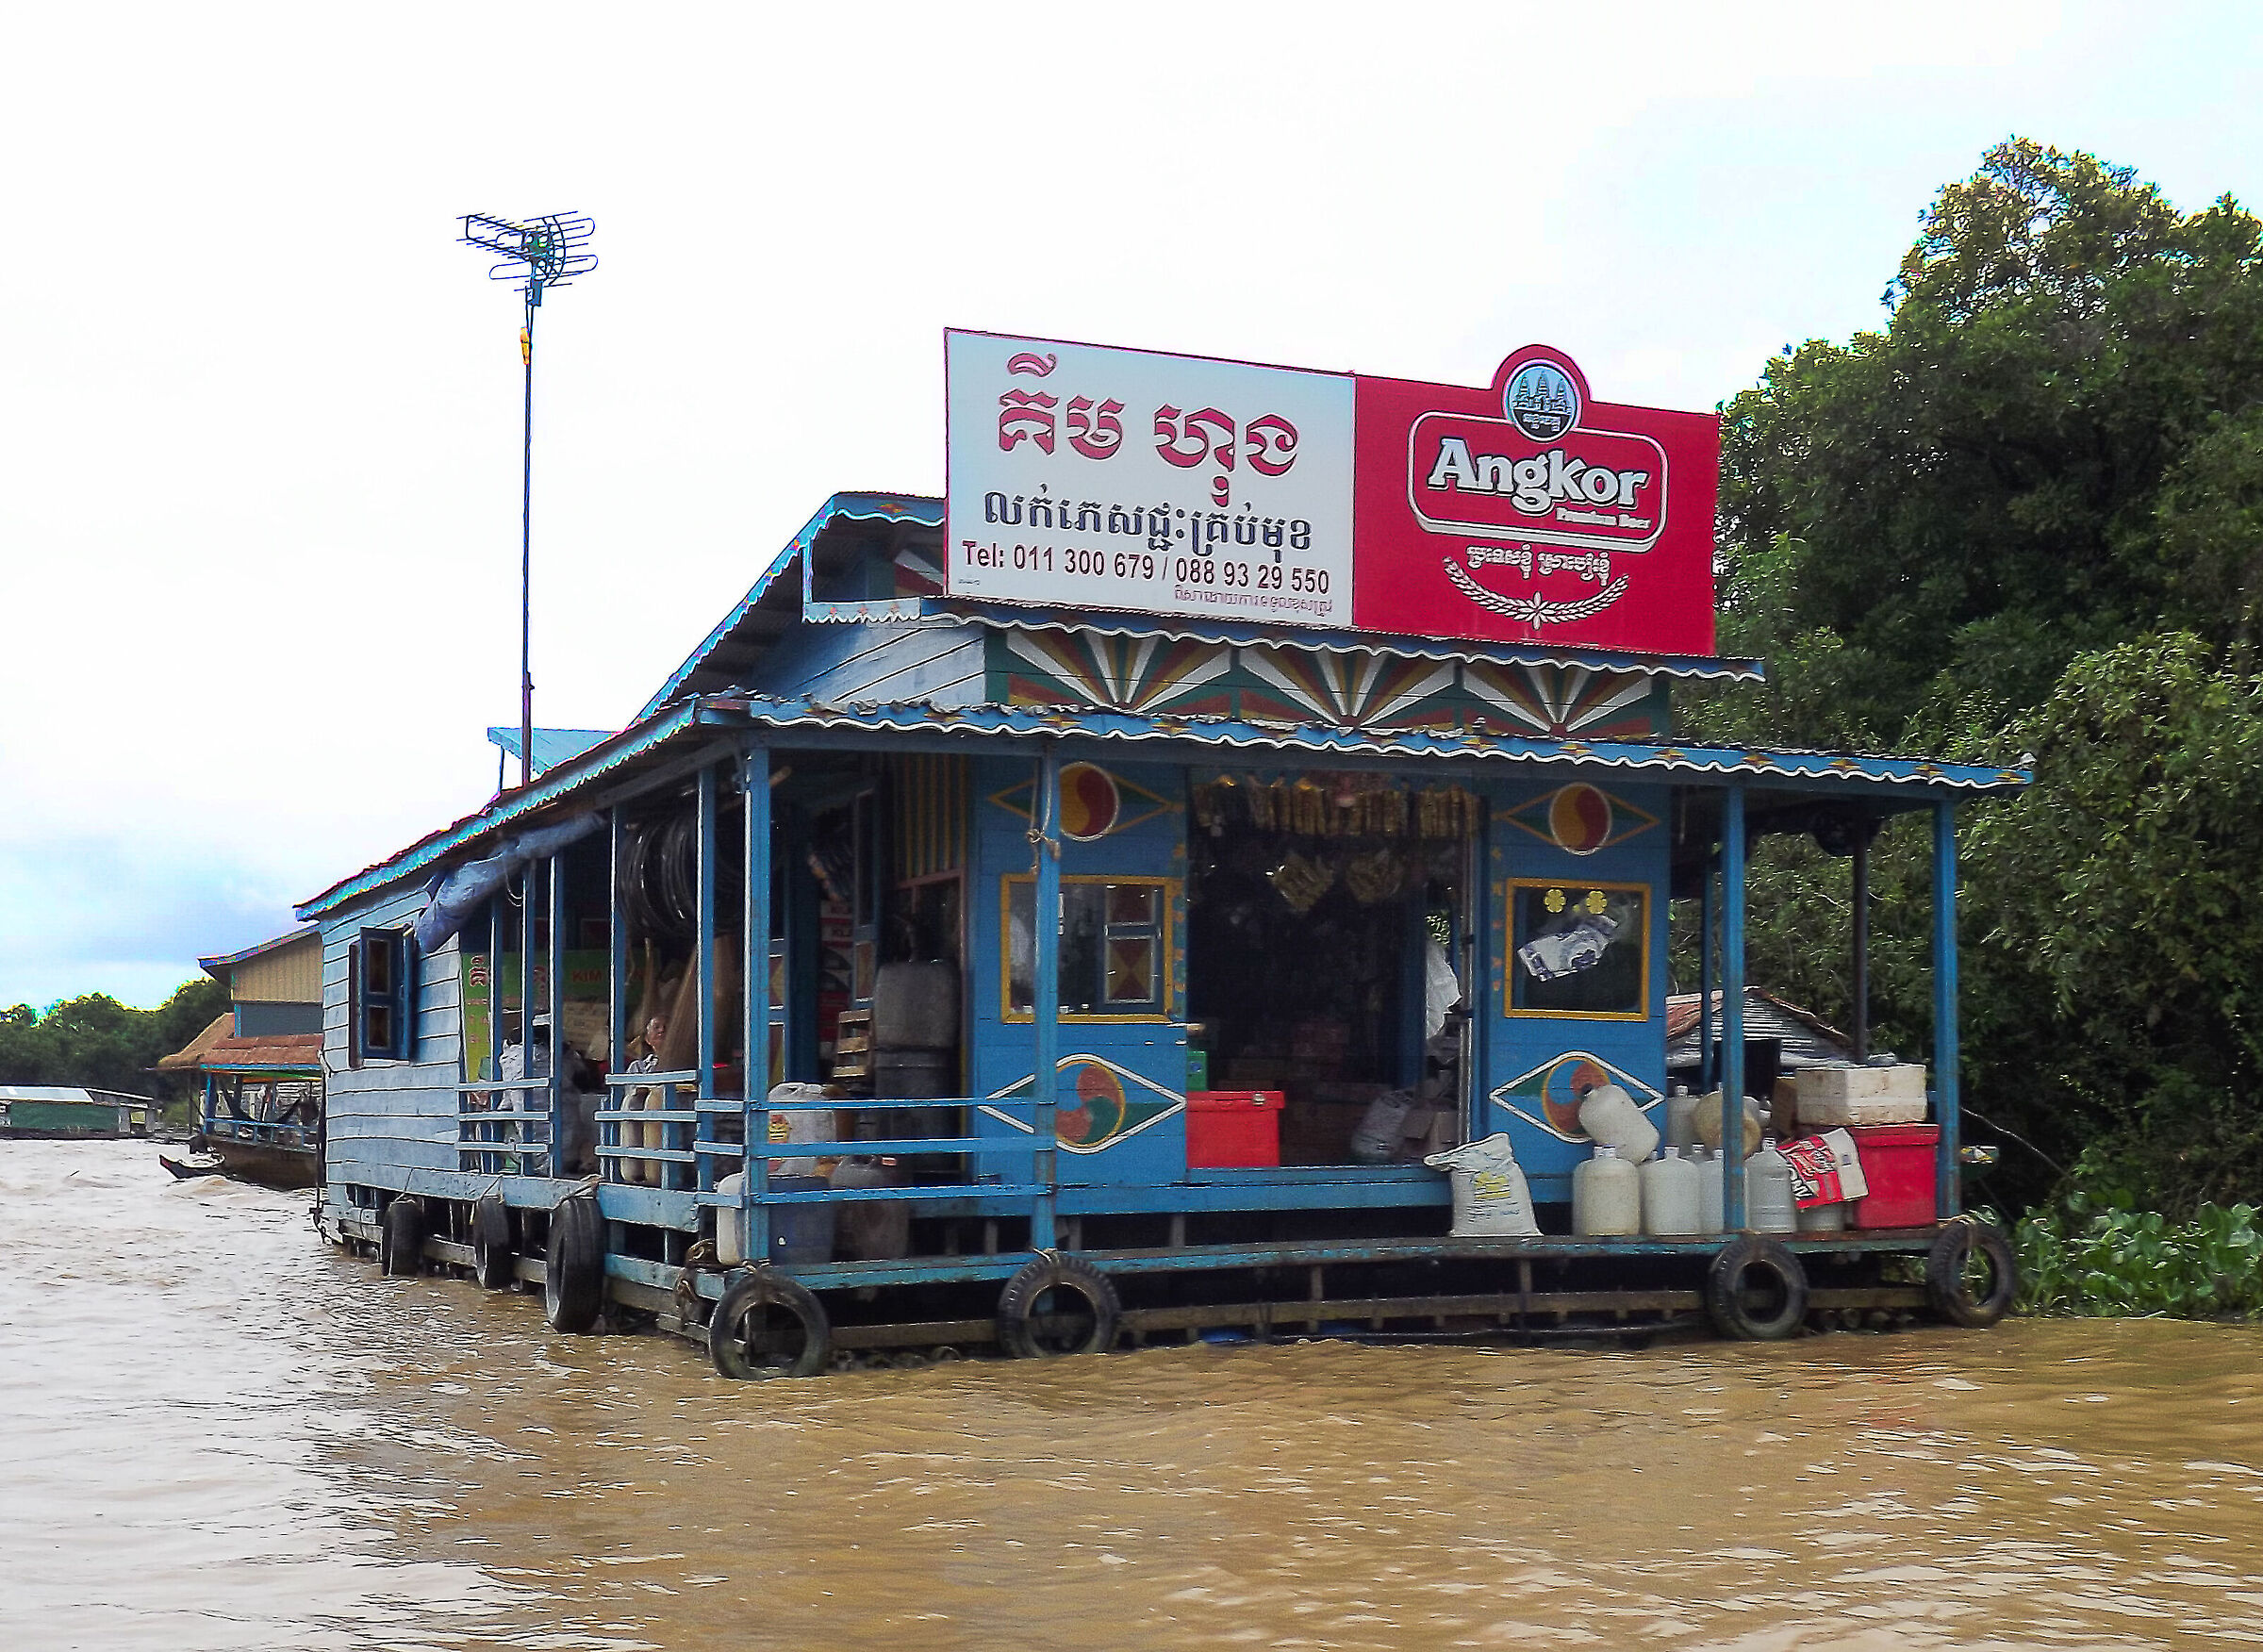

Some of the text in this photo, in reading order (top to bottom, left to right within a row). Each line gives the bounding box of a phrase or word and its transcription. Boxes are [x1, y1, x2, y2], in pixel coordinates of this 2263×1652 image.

[999, 352, 1298, 507] គីម ហុង
[1427, 438, 1649, 517] Angkor
[962, 540, 1004, 568] Tel:
[1014, 544, 1052, 571] 011
[1064, 548, 1105, 576] 300
[1114, 552, 1155, 580] 679
[1176, 557, 1214, 585] 088
[1223, 561, 1248, 587] 93
[1257, 564, 1282, 590] 29
[1291, 568, 1330, 595] 550
